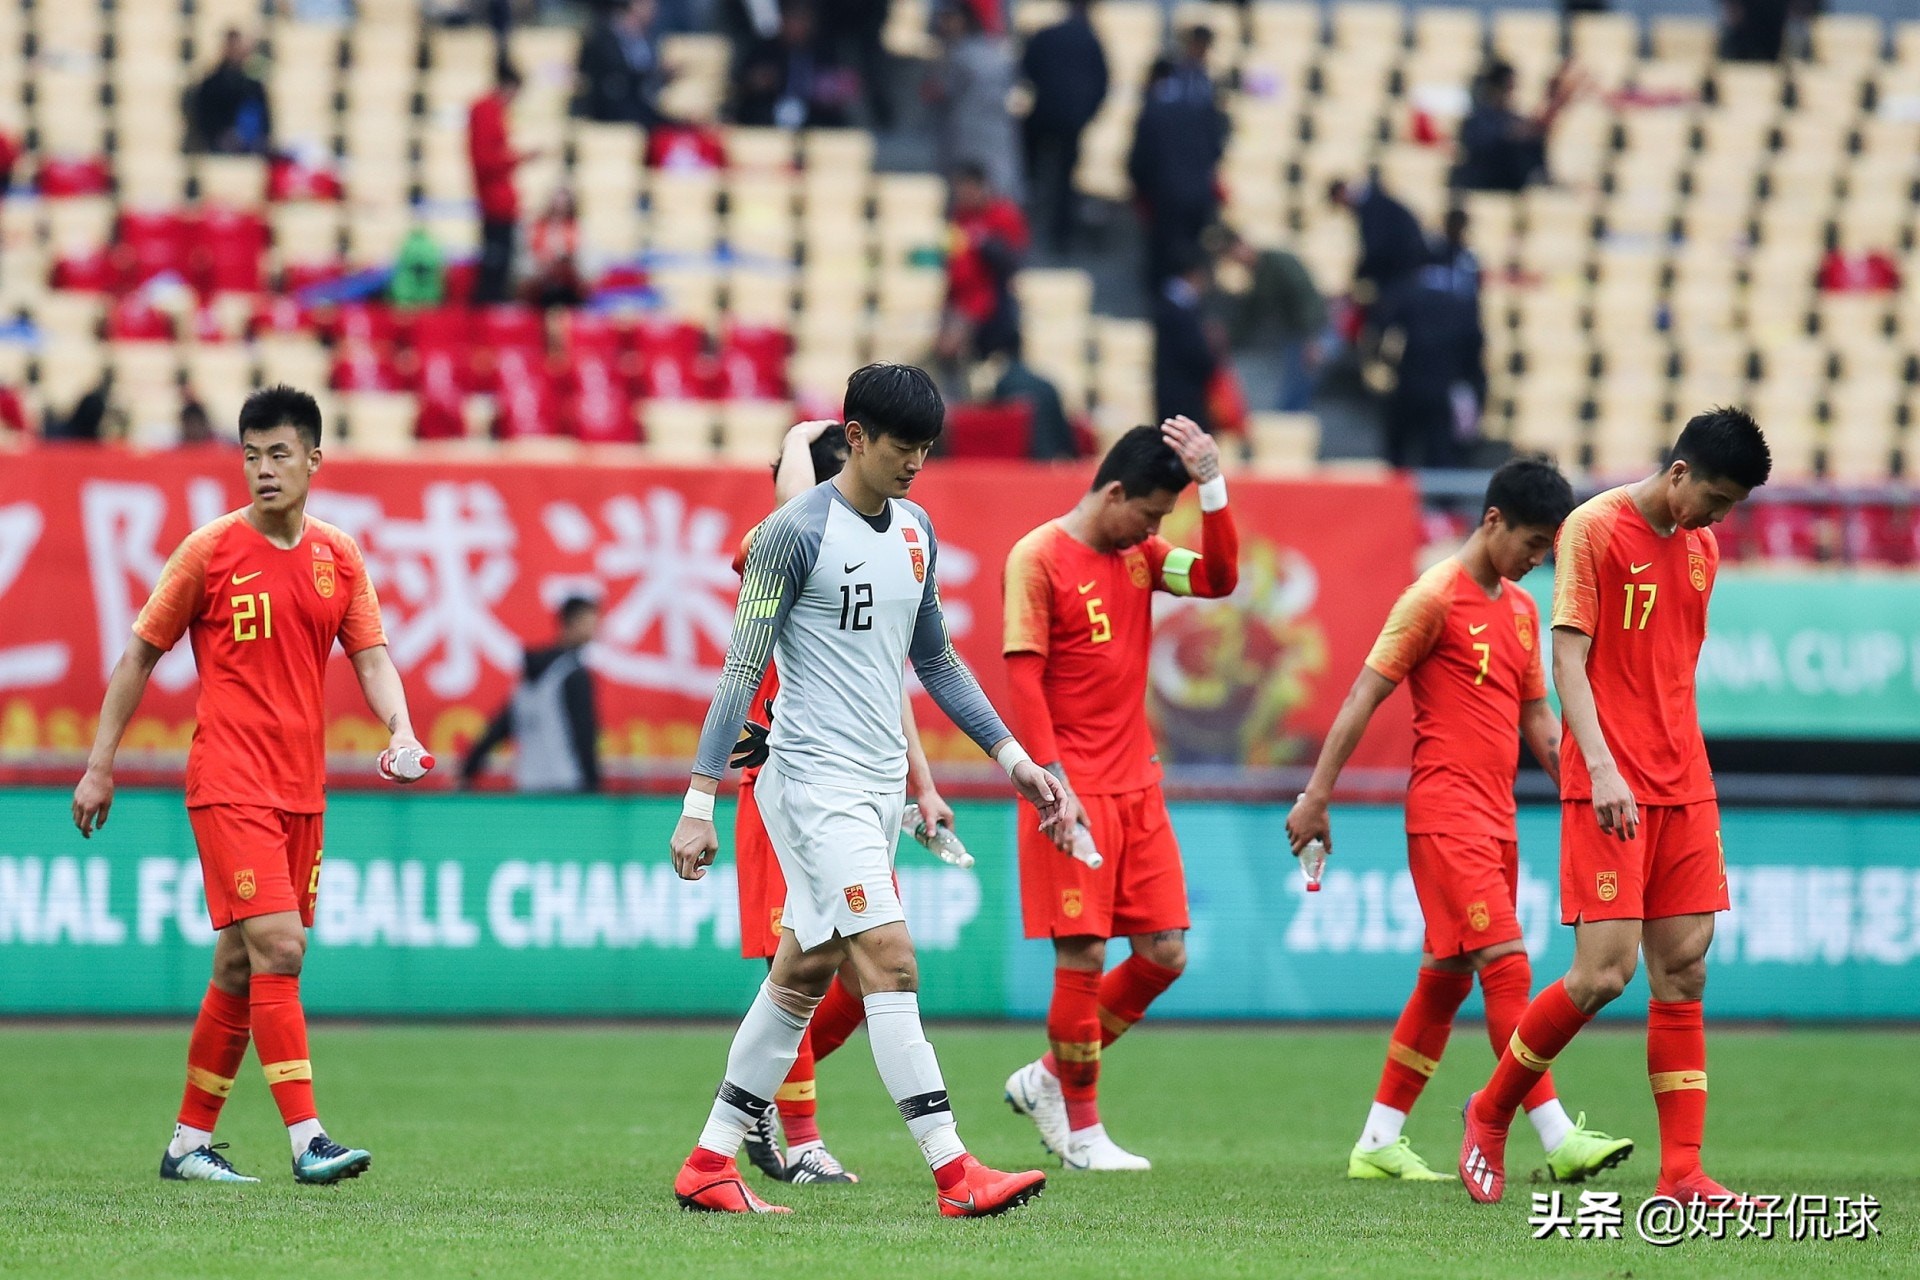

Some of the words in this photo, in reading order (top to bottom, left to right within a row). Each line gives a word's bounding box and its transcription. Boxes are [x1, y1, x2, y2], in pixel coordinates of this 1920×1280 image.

[231, 592, 272, 642] 21
[839, 583, 873, 631] 12
[1086, 598, 1112, 643] 5
[1623, 584, 1657, 630] 17
[1472, 643, 1490, 686] 7
[1786, 628, 1906, 695] CUP
[137, 856, 481, 948] FOBALL
